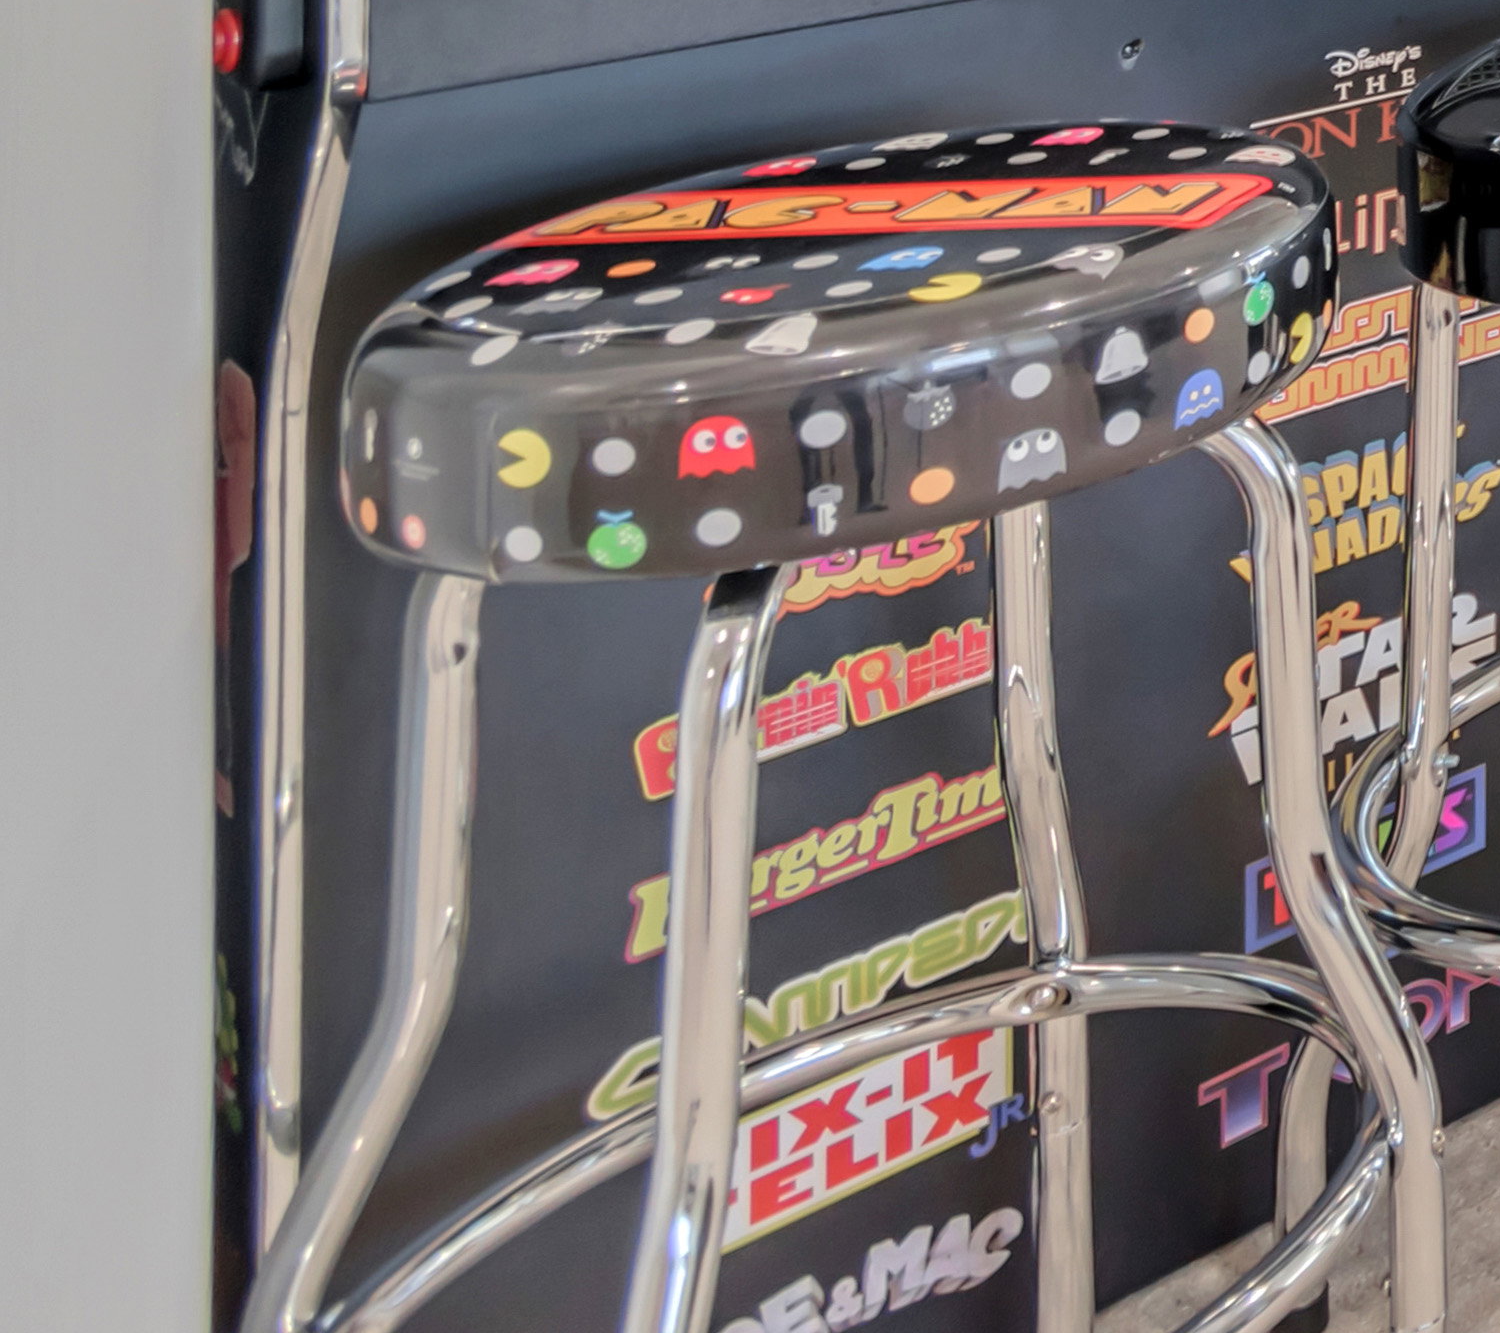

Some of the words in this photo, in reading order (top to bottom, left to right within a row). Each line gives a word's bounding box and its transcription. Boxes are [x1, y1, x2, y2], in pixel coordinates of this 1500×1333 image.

[1334, 68, 1417, 102] THE
[534, 180, 1224, 236] PAC-MAN
[729, 1071, 993, 1226] ELIX
[748, 1027, 995, 1174] IX-IT
[861, 1208, 1025, 1323] MAC
